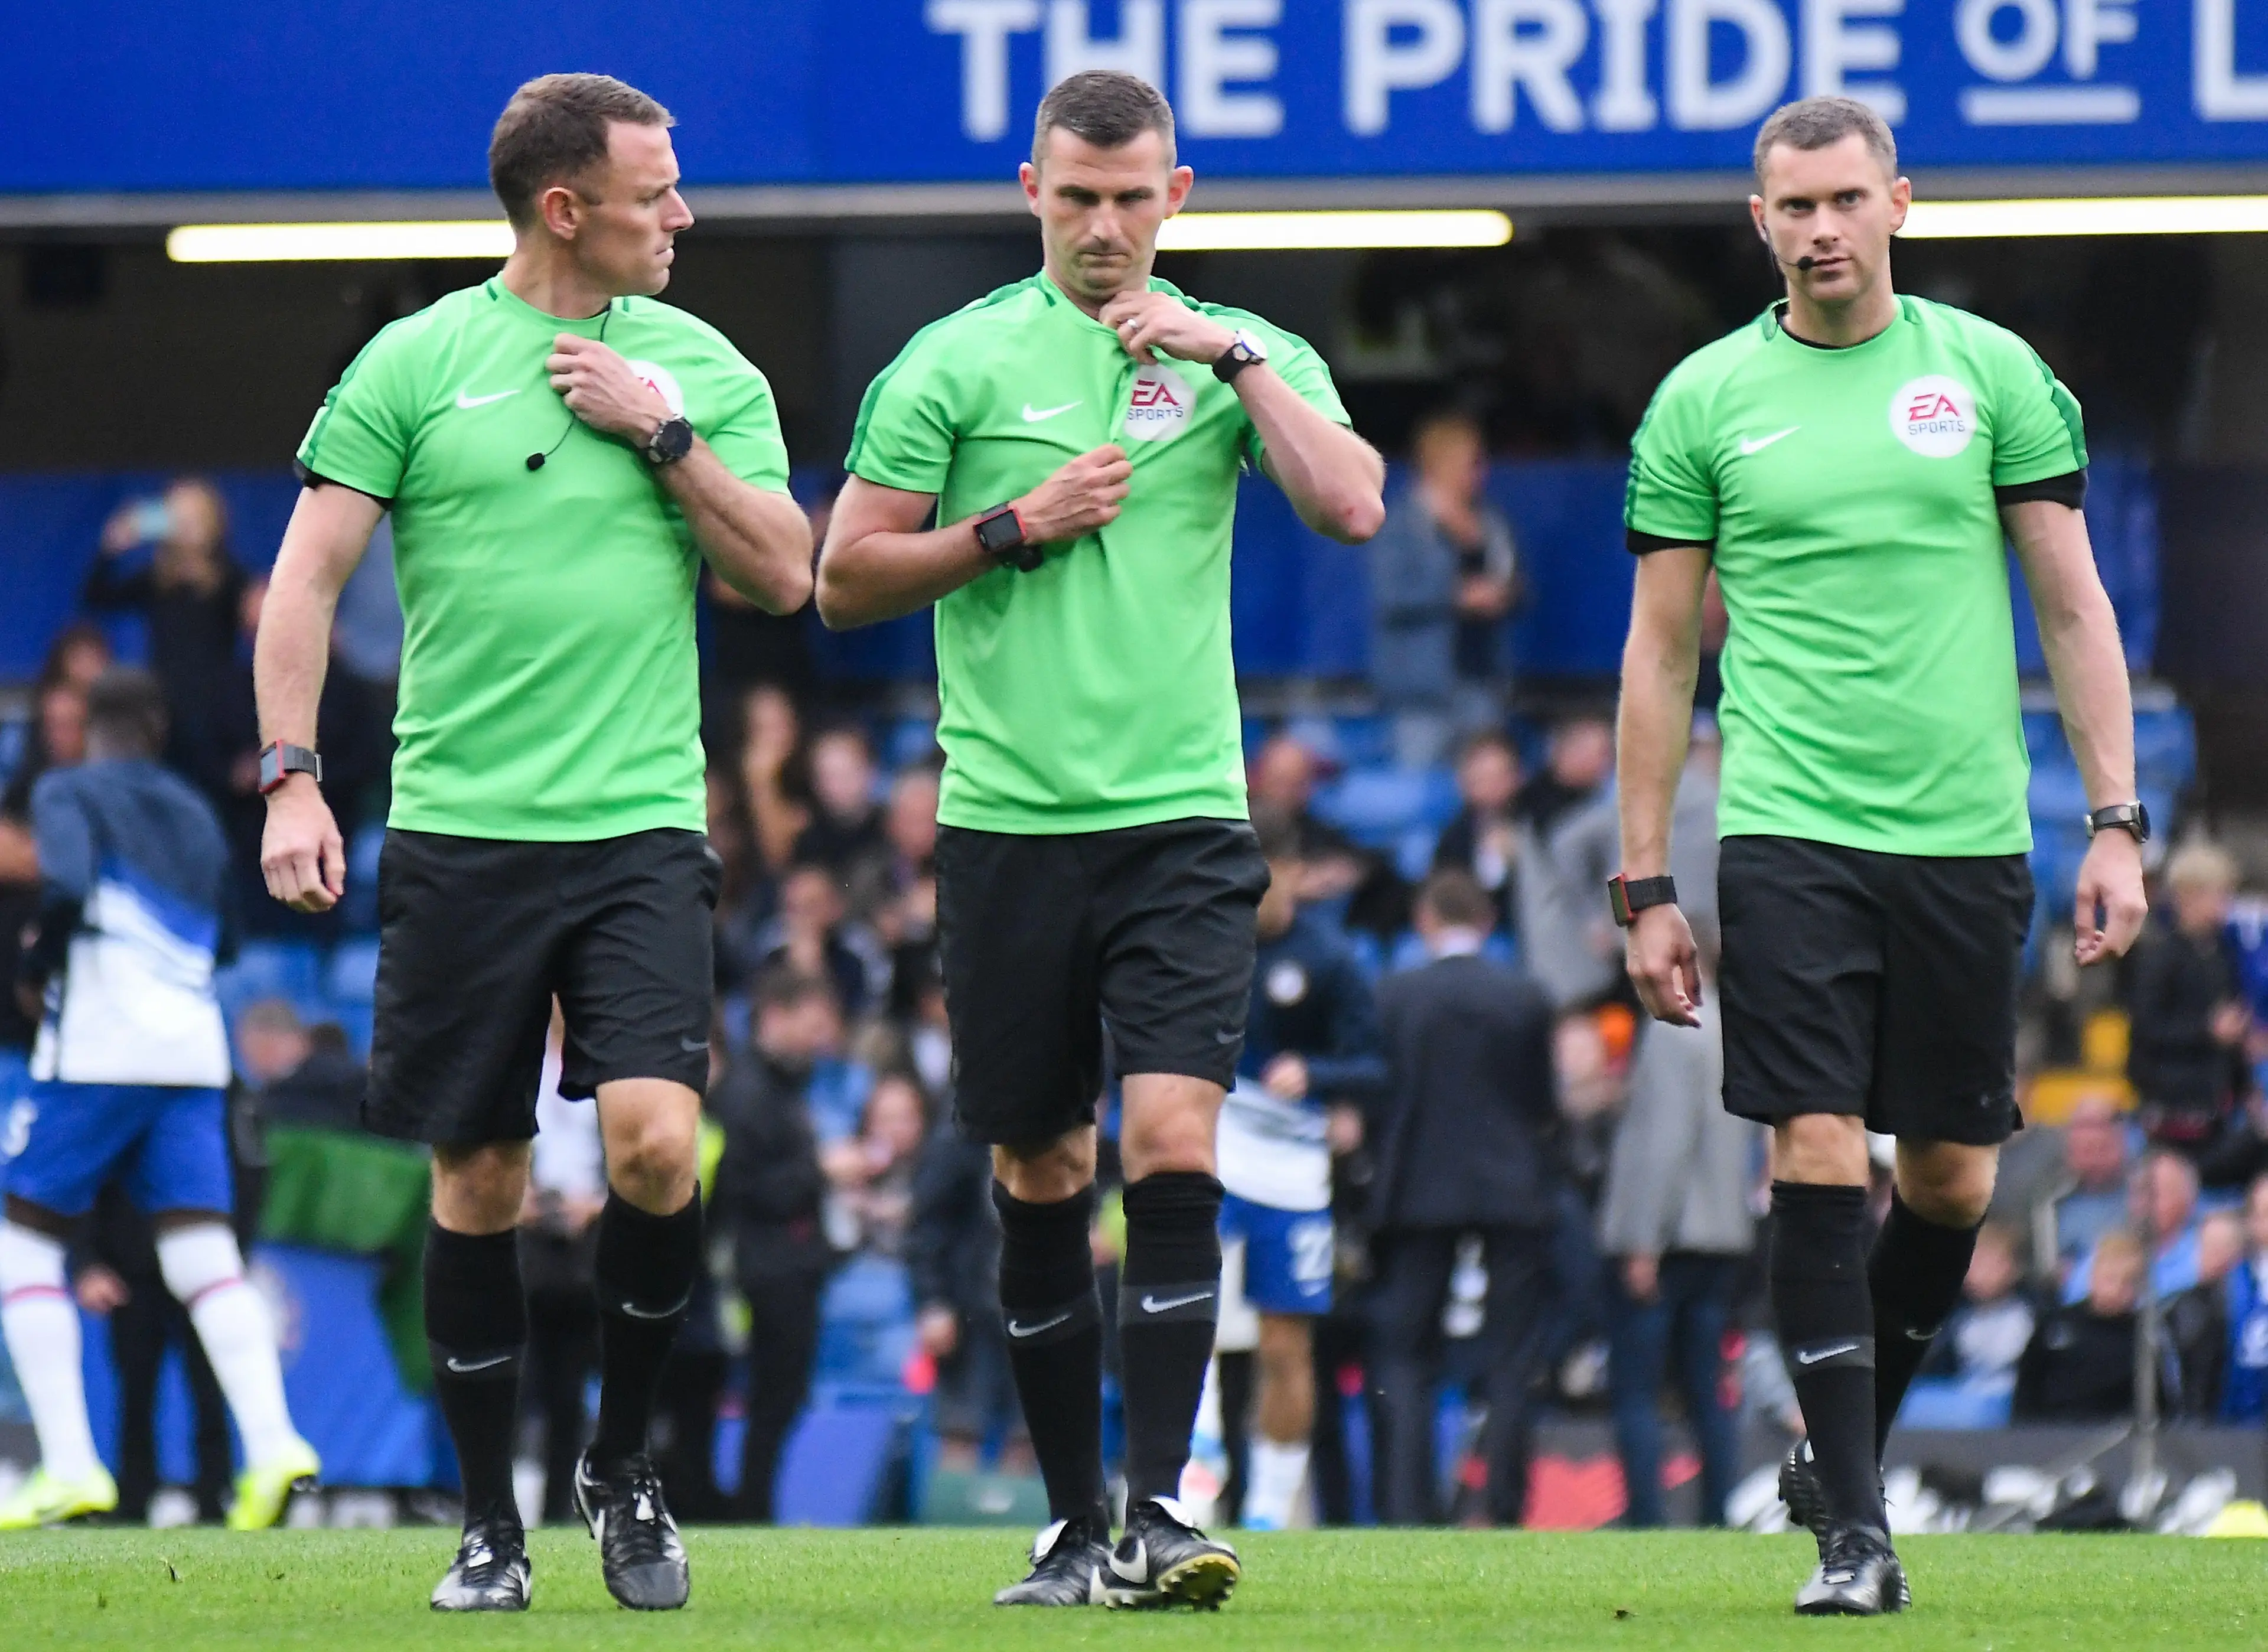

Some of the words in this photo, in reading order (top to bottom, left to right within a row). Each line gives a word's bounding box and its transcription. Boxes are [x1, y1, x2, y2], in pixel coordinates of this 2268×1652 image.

[927, 0, 1284, 142] THE
[1342, 0, 1908, 136] PRIDE
[1955, 0, 2139, 83] OF
[1131, 379, 1179, 406] EA
[1127, 406, 1184, 421] SPORTS
[1908, 392, 1960, 422] EA
[1908, 420, 1966, 436] SPORTS
